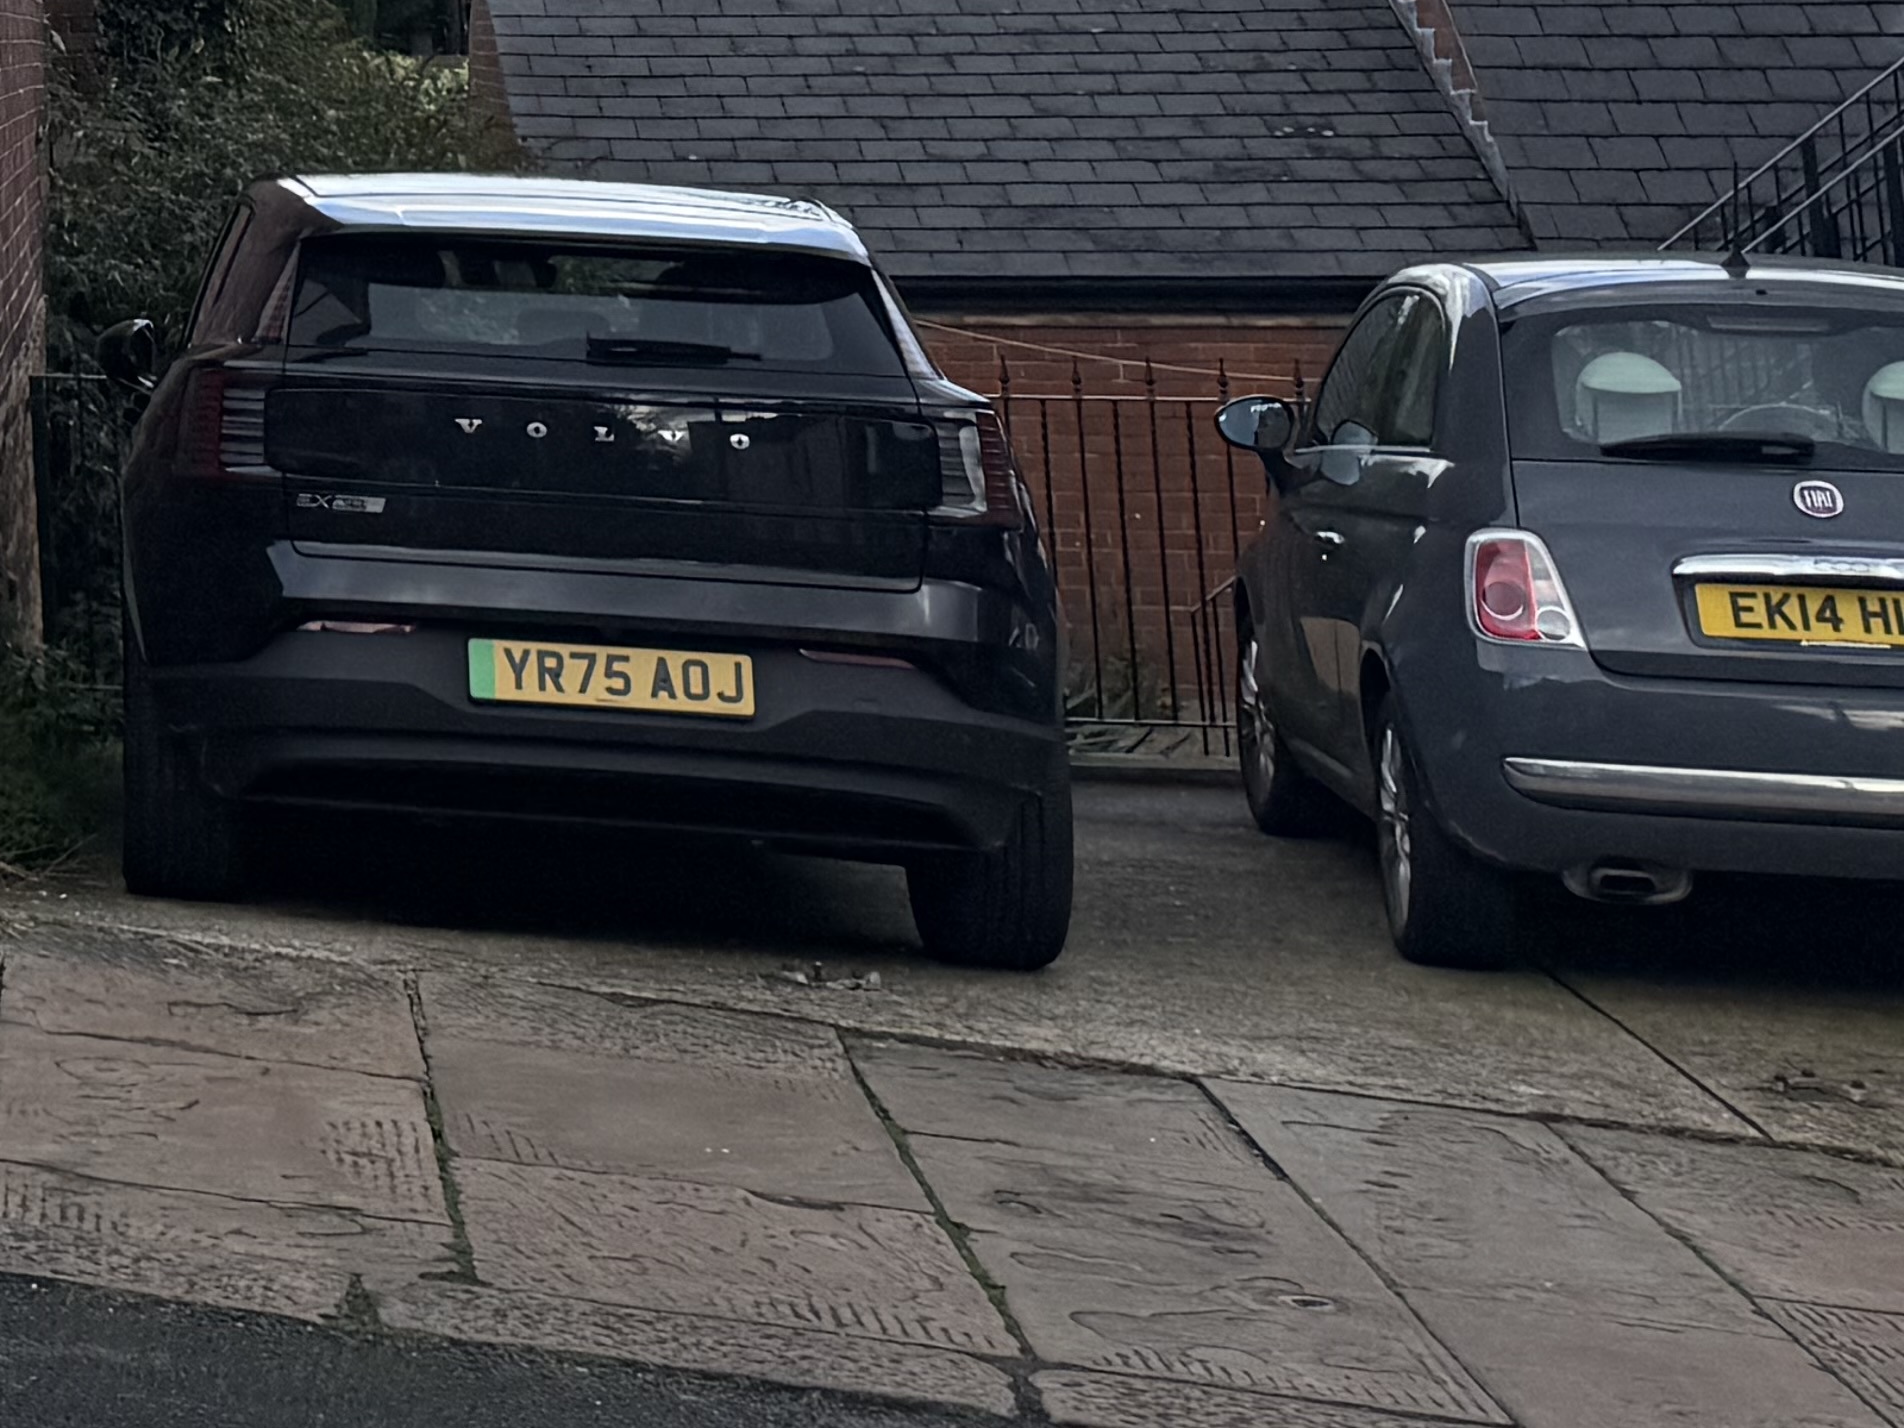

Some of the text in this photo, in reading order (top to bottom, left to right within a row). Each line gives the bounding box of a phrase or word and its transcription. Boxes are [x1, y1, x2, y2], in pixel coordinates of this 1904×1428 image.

[455, 417, 751, 450] VOLVO
[1728, 590, 1845, 633] EK14
[502, 647, 745, 704] YR75 AOJ
